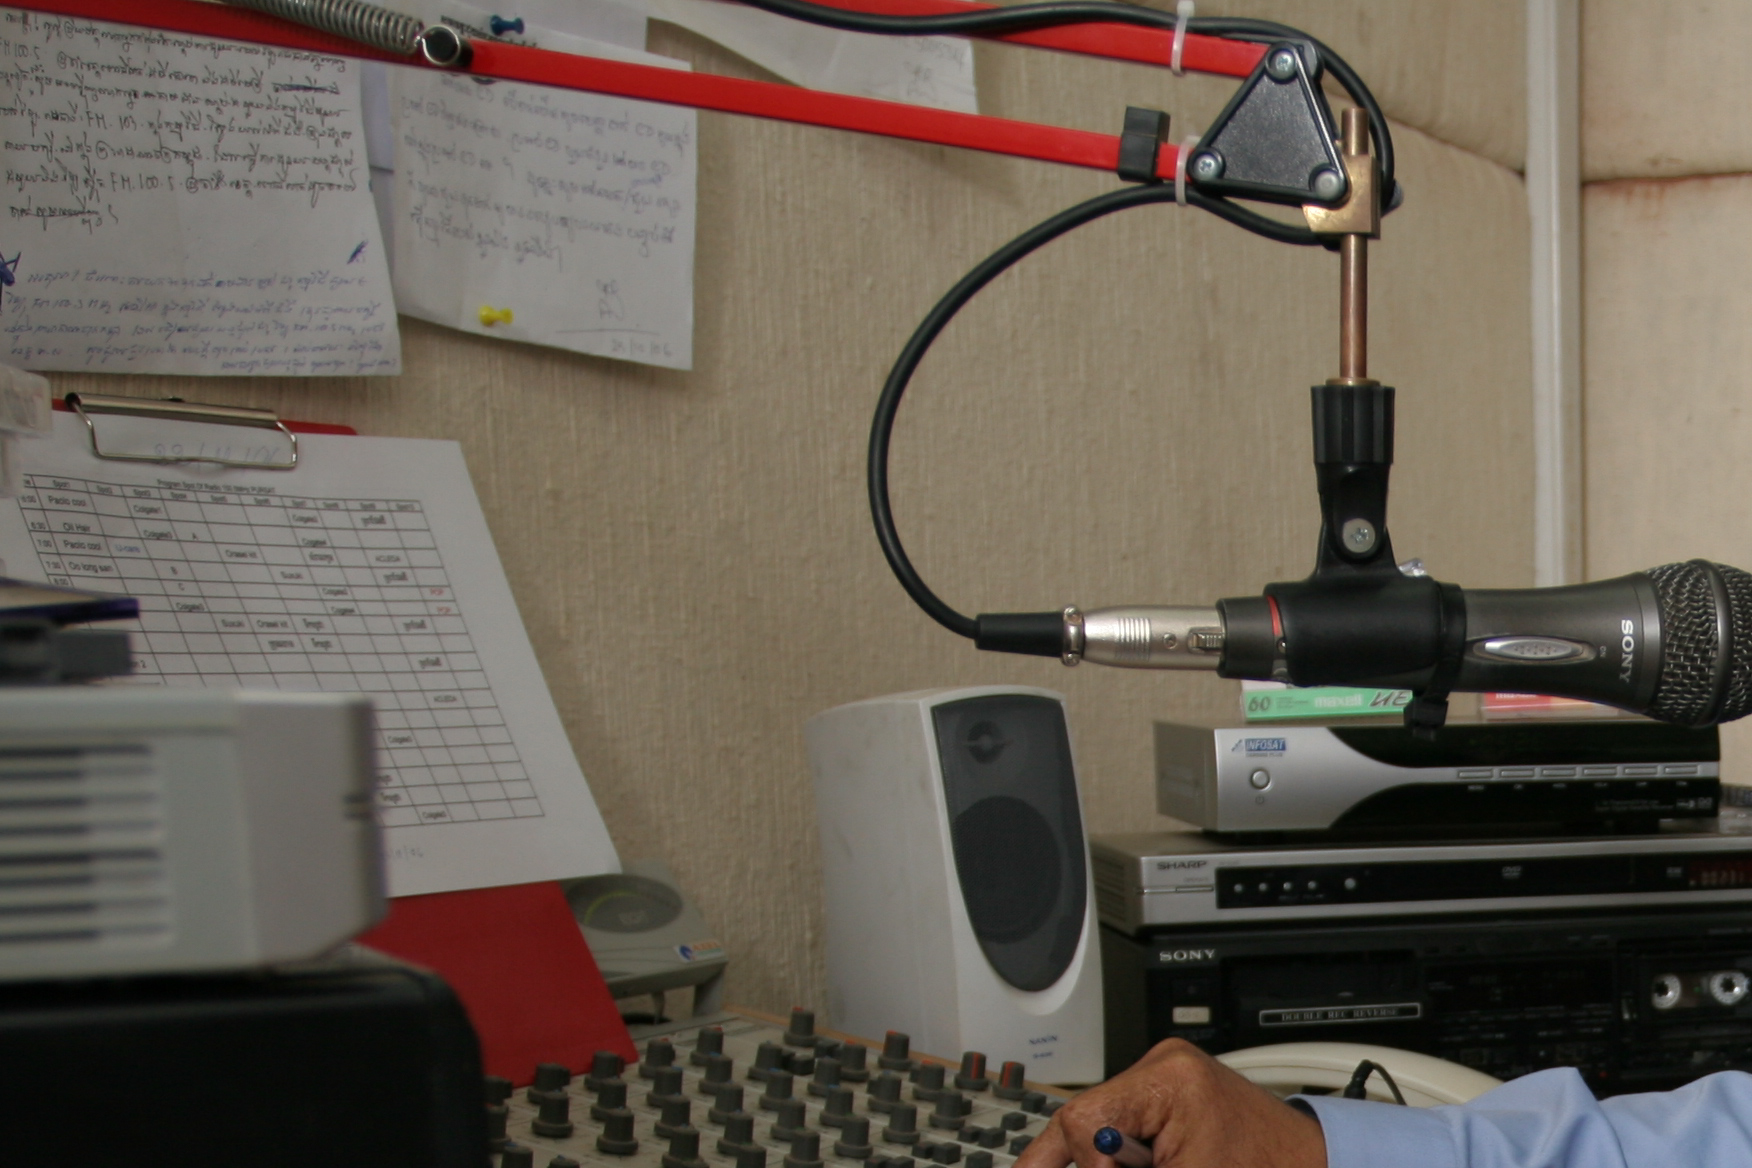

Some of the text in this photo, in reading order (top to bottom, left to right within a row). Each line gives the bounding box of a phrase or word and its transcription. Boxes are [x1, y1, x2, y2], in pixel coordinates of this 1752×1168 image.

[1618, 618, 1635, 684] SONY
[1247, 693, 1365, 712] 60 maxell
[1246, 738, 1286, 751] INFOSAT
[1156, 860, 1207, 870] SHARP
[1159, 949, 1216, 962] SONY
[1281, 1007, 1399, 1022] DOUBLE REC REVERSE
